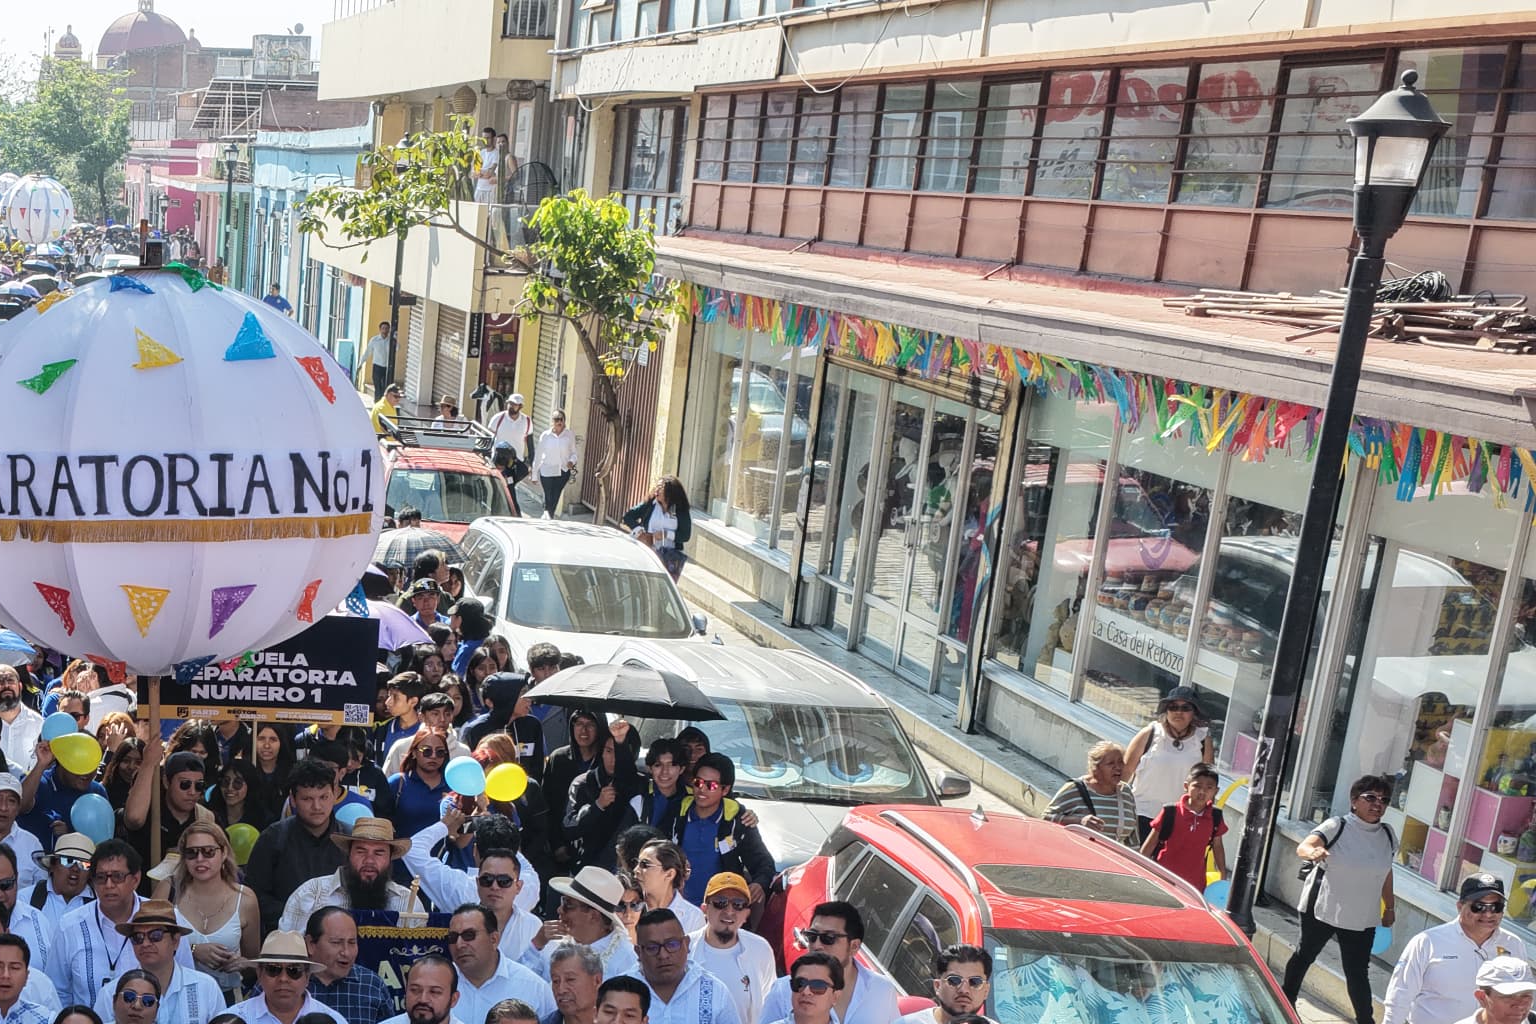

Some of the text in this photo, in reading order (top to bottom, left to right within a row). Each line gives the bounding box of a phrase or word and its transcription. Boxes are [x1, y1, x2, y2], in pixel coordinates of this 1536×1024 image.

[1092, 616, 1185, 673] La Casa del Rebozo
[190, 684, 322, 704] NUMERO 1
